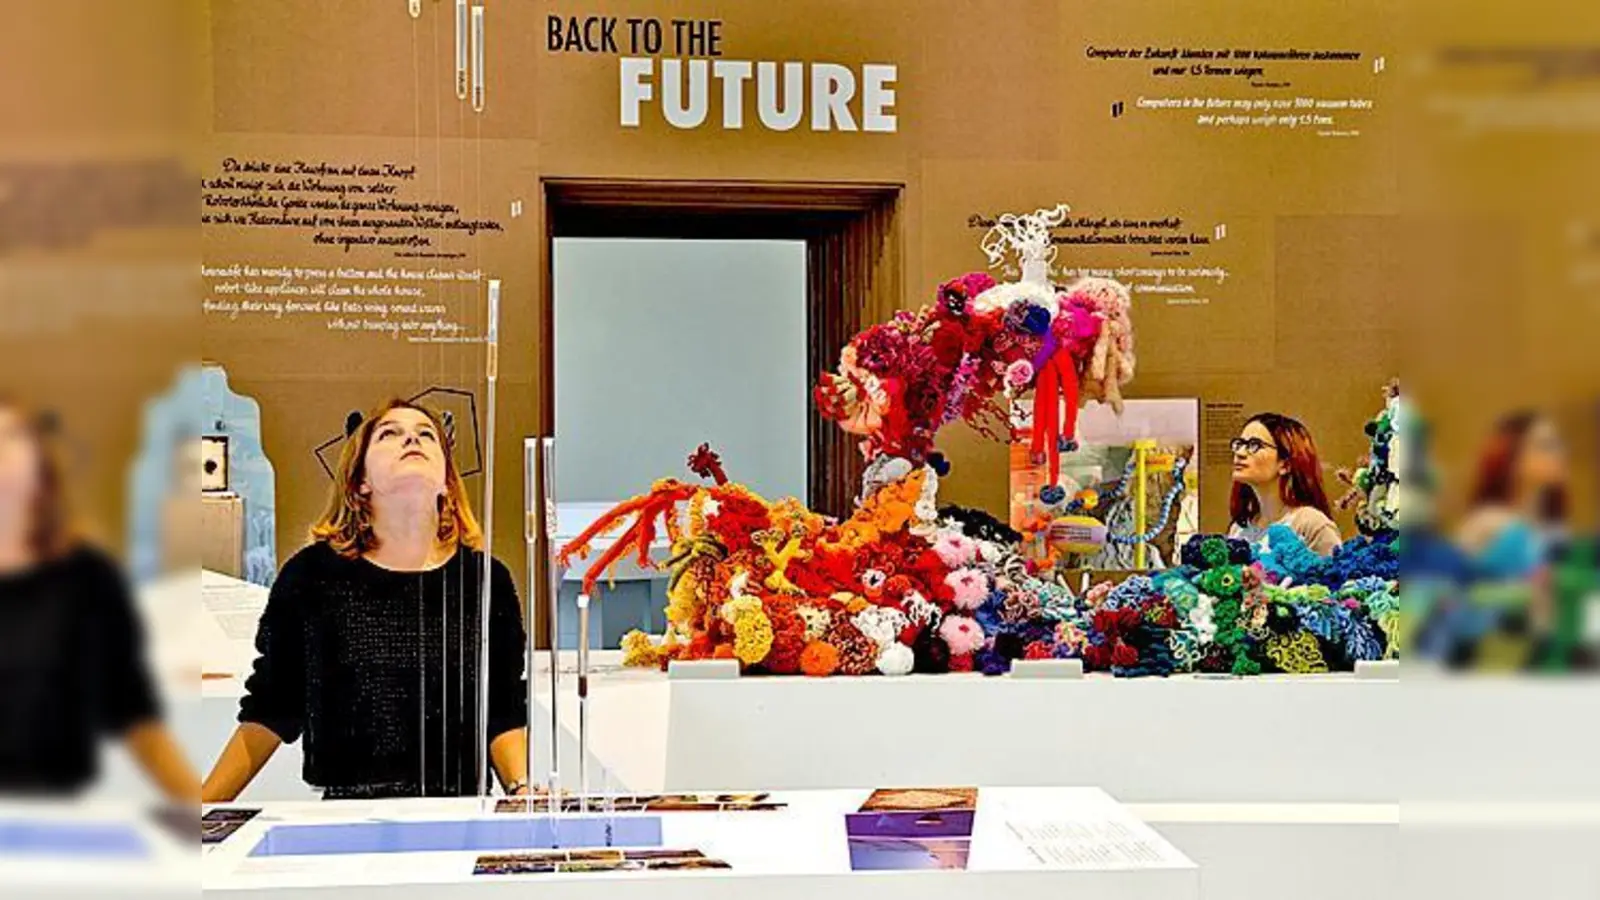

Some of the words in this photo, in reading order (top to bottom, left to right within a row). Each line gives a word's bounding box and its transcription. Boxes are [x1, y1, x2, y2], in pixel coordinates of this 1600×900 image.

[547, 15, 618, 52] BACK
[626, 18, 662, 54] TO
[672, 20, 722, 56] THE
[1086, 46, 1127, 60] Computer
[620, 57, 898, 131] FUTURE
